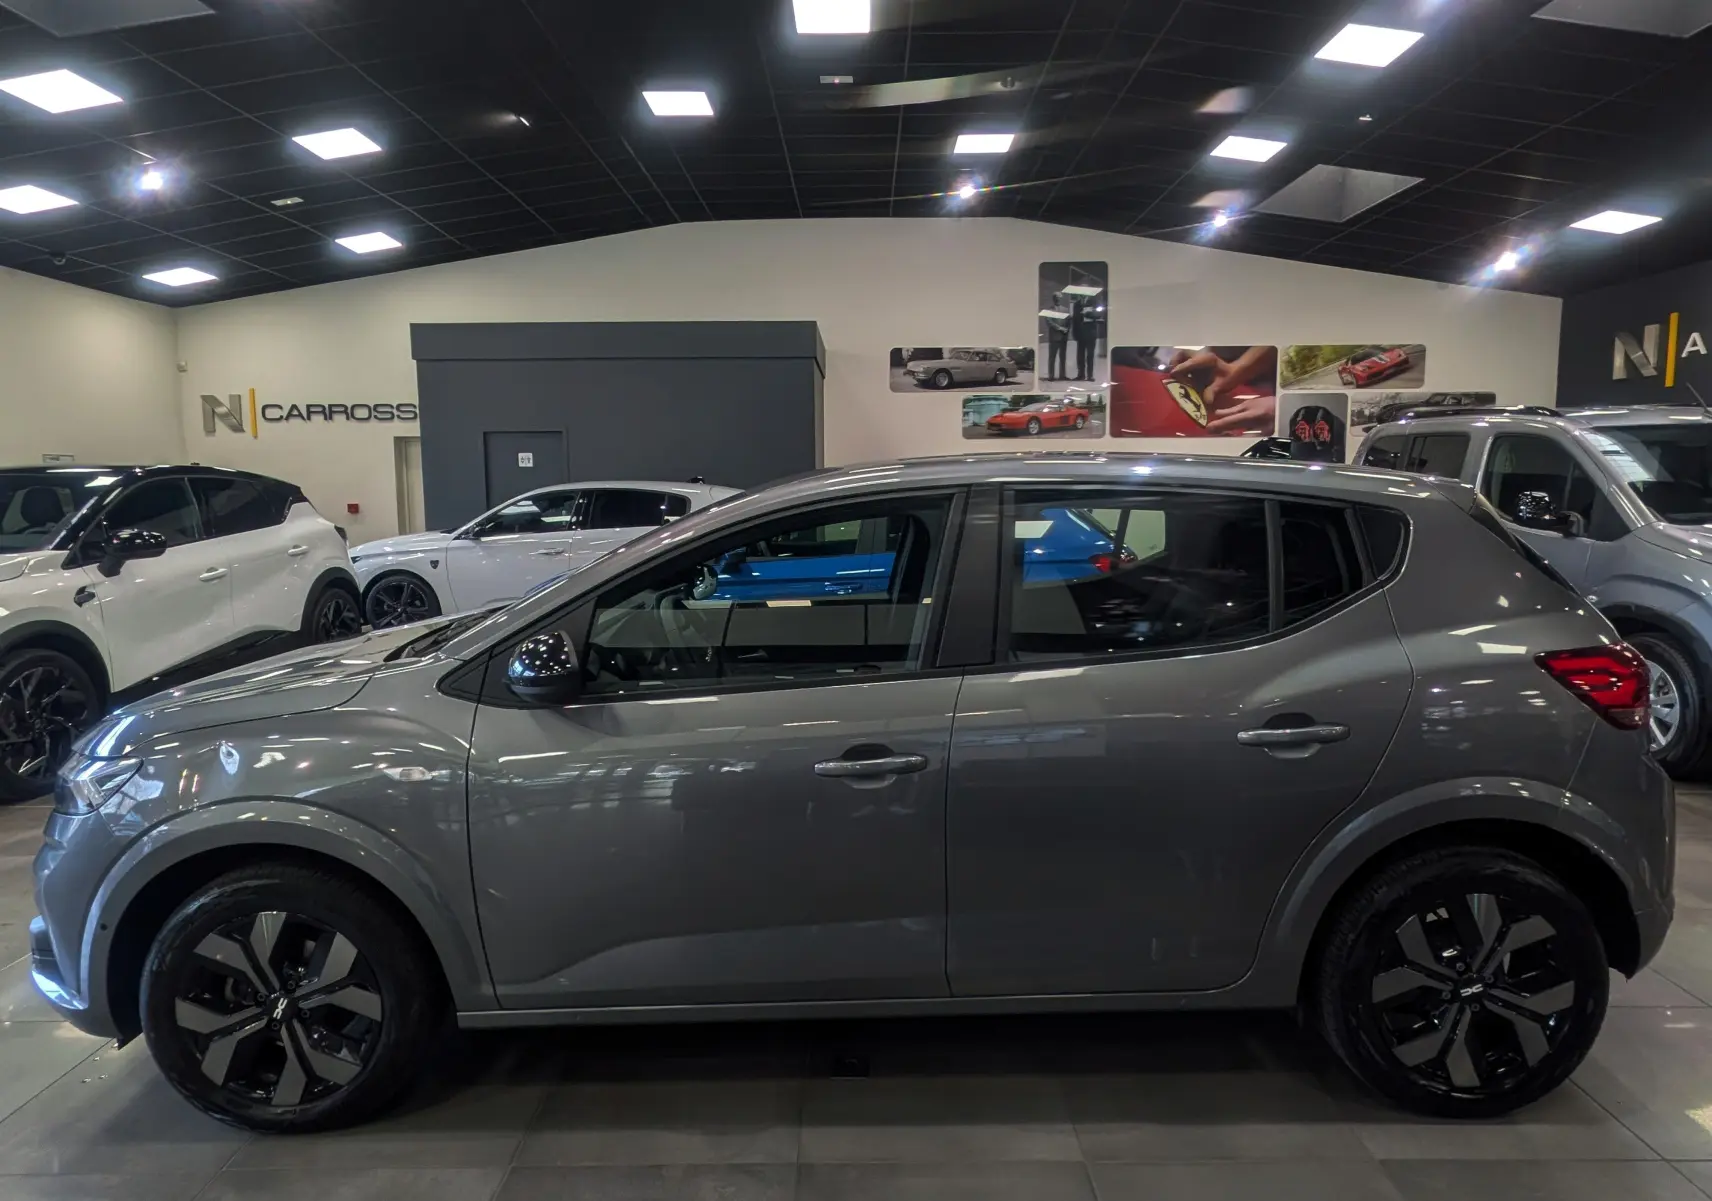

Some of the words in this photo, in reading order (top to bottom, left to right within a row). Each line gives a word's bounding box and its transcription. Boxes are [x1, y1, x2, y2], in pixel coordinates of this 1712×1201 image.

[1613, 324, 1659, 380] N
[1681, 332, 1708, 358] A
[200, 394, 245, 433] N
[261, 403, 418, 421] CARROSS
